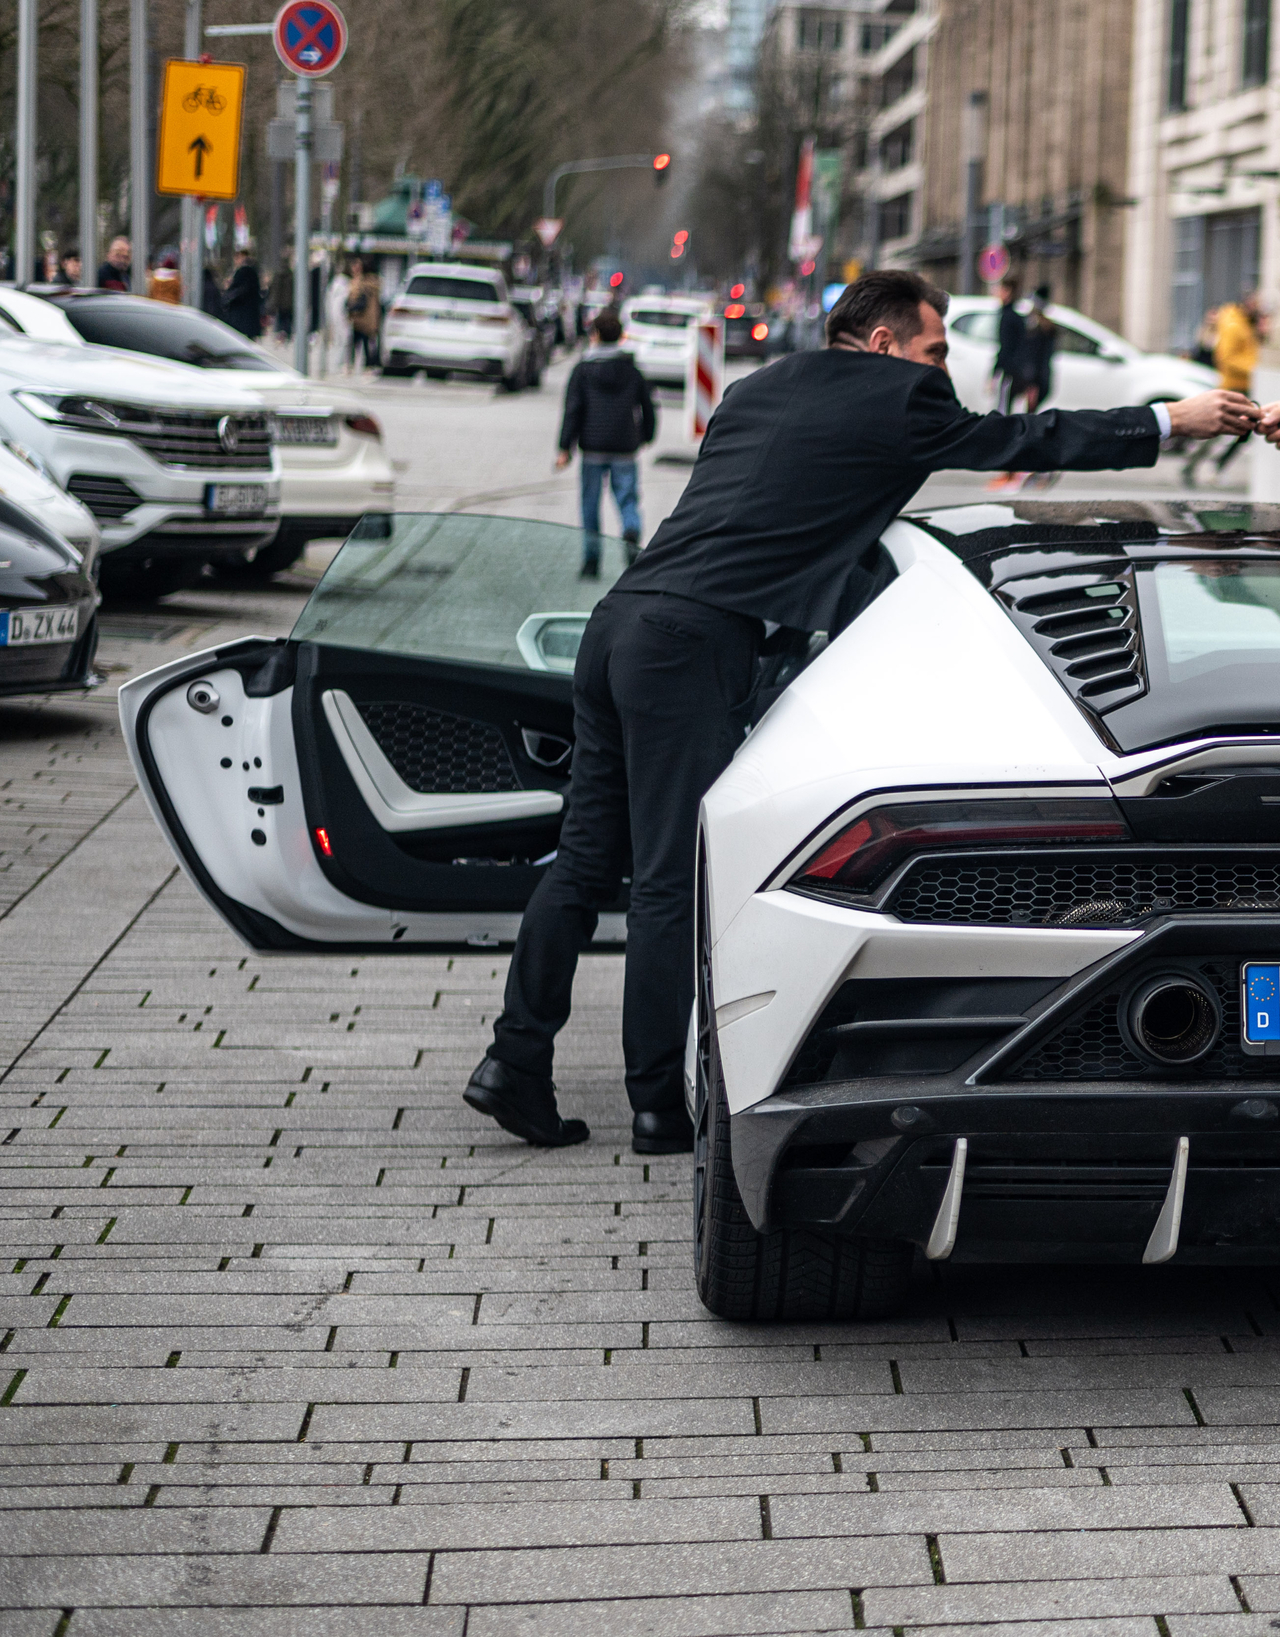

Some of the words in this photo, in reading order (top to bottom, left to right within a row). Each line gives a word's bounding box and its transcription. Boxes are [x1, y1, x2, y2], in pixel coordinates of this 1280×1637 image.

[12, 614, 23, 640] D
[34, 611, 55, 639] ZX
[57, 610, 75, 636] 44
[1257, 1012, 1269, 1028] D
